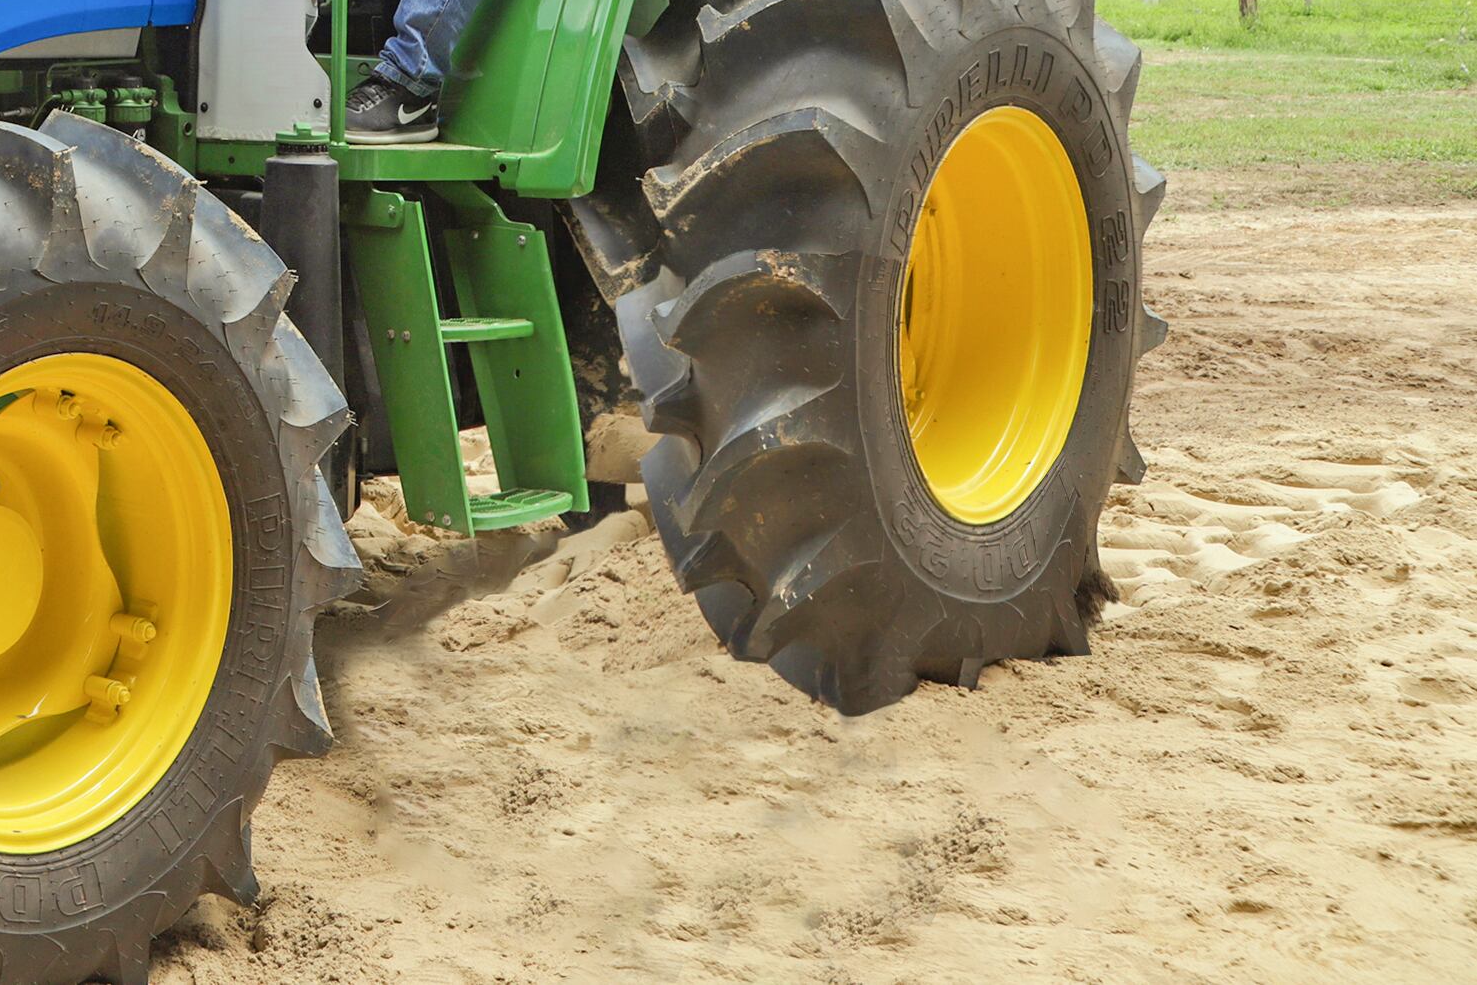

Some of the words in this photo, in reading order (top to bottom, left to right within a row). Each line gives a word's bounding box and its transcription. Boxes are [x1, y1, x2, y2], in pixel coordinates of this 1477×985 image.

[890, 44, 1054, 255] PIRELLI
[1059, 76, 1113, 179] PD
[1101, 208, 1128, 334] 22
[148, 492, 286, 855] PIRELLI
